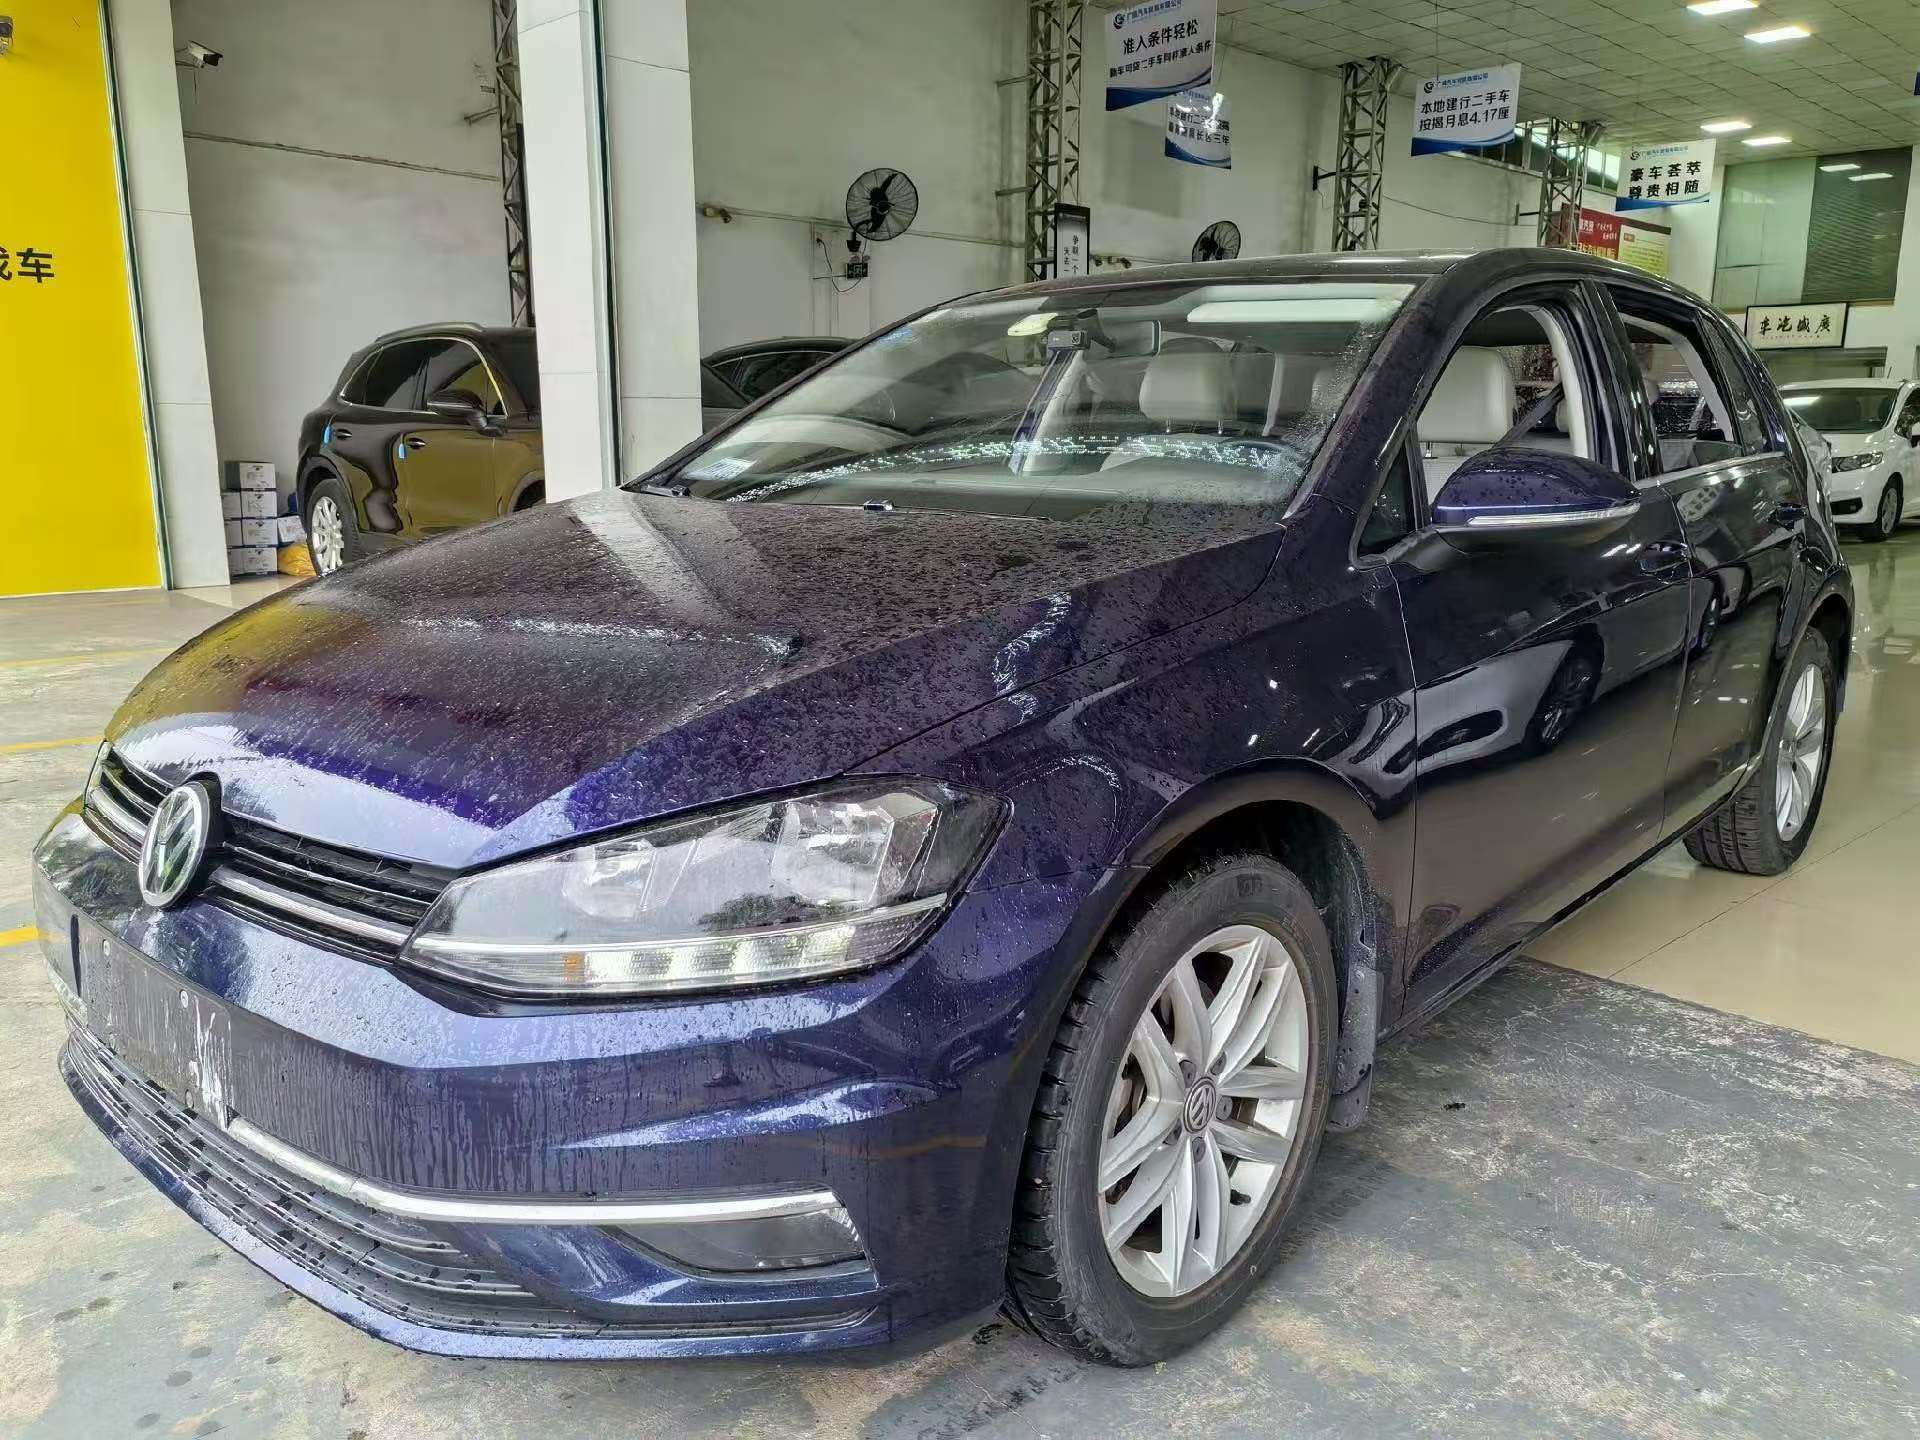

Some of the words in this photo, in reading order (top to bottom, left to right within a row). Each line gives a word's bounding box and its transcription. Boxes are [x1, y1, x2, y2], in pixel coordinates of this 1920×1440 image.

[1123, 19, 1199, 55] 准入条件轻松
[1421, 89, 1511, 114] 本地建行二手车
[1419, 106, 1510, 132] 按揭月息4.17厘
[1630, 161, 1702, 182] 豪车荟萃
[1629, 180, 1700, 200] 尊贵相随
